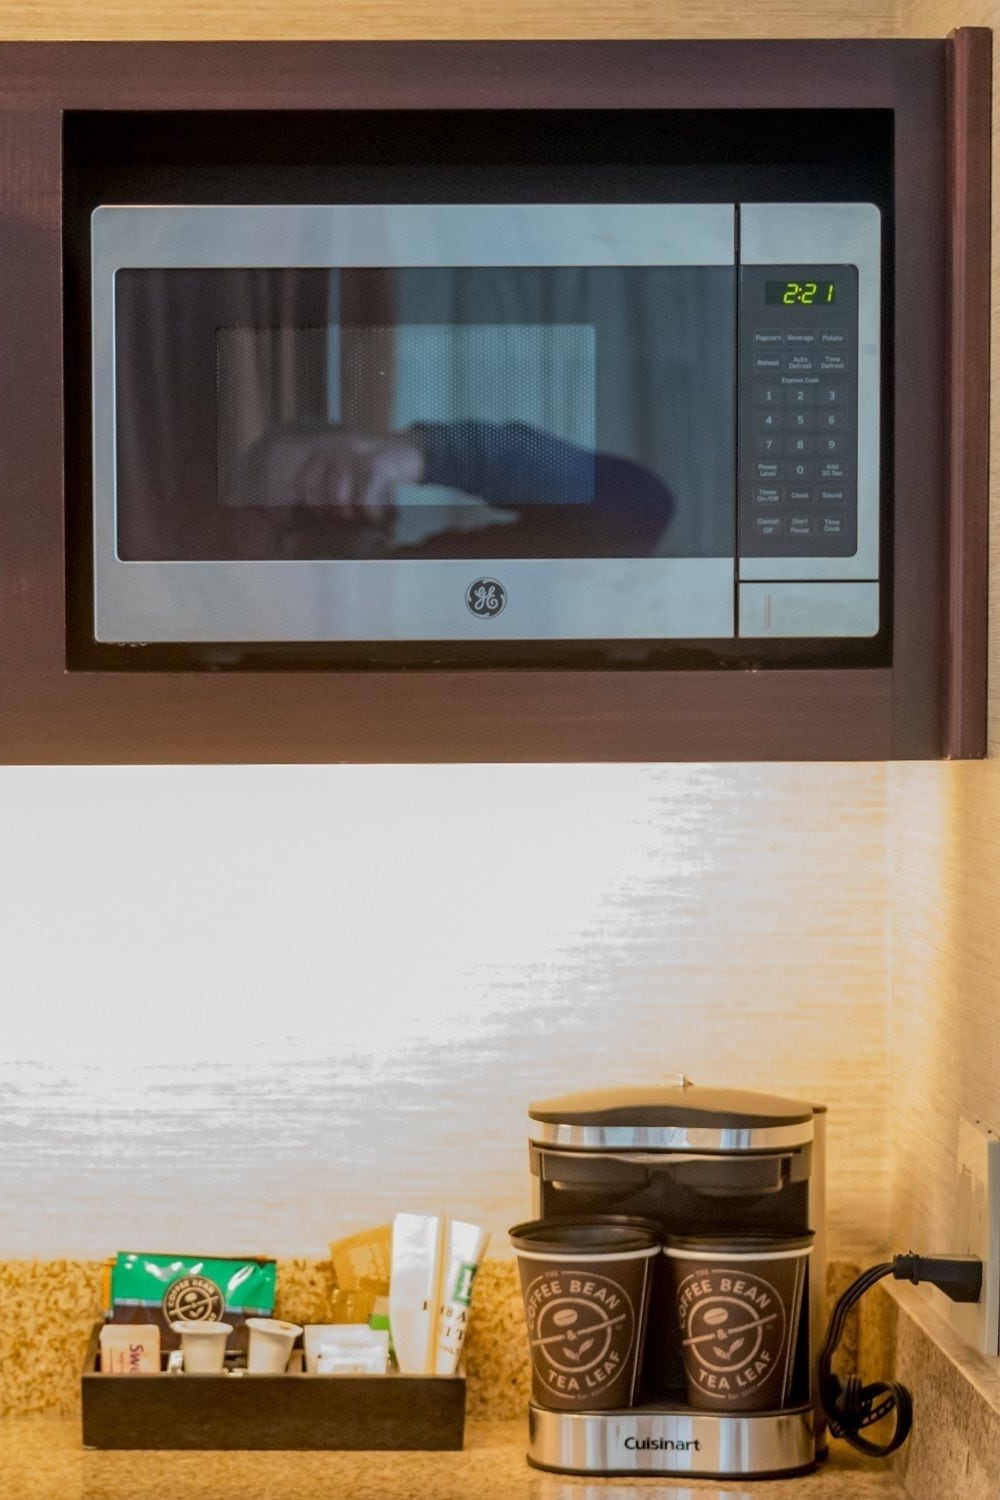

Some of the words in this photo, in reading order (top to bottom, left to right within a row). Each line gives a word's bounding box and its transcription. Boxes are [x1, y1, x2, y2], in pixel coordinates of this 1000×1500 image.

[783, 283, 834, 304] 2:21
[767, 391, 772, 400] 1
[797, 391, 804, 400] 2
[828, 391, 836, 400] 3
[765, 415, 773, 424] 4
[797, 415, 804, 424] 5
[828, 415, 836, 424] 6
[765, 440, 773, 449] 7
[797, 440, 804, 449] 8
[828, 440, 836, 449] 9
[527, 1280, 562, 1330] COFFEE
[570, 1279, 620, 1310] BEAN
[678, 1279, 713, 1329] COFFEE
[720, 1278, 772, 1309] BEAN
[548, 1369, 580, 1391] TEA
[585, 1350, 620, 1387] LEAF
[698, 1368, 730, 1390] TEA
[736, 1350, 771, 1387] LEAF
[624, 1436, 702, 1452] Cuisinart
